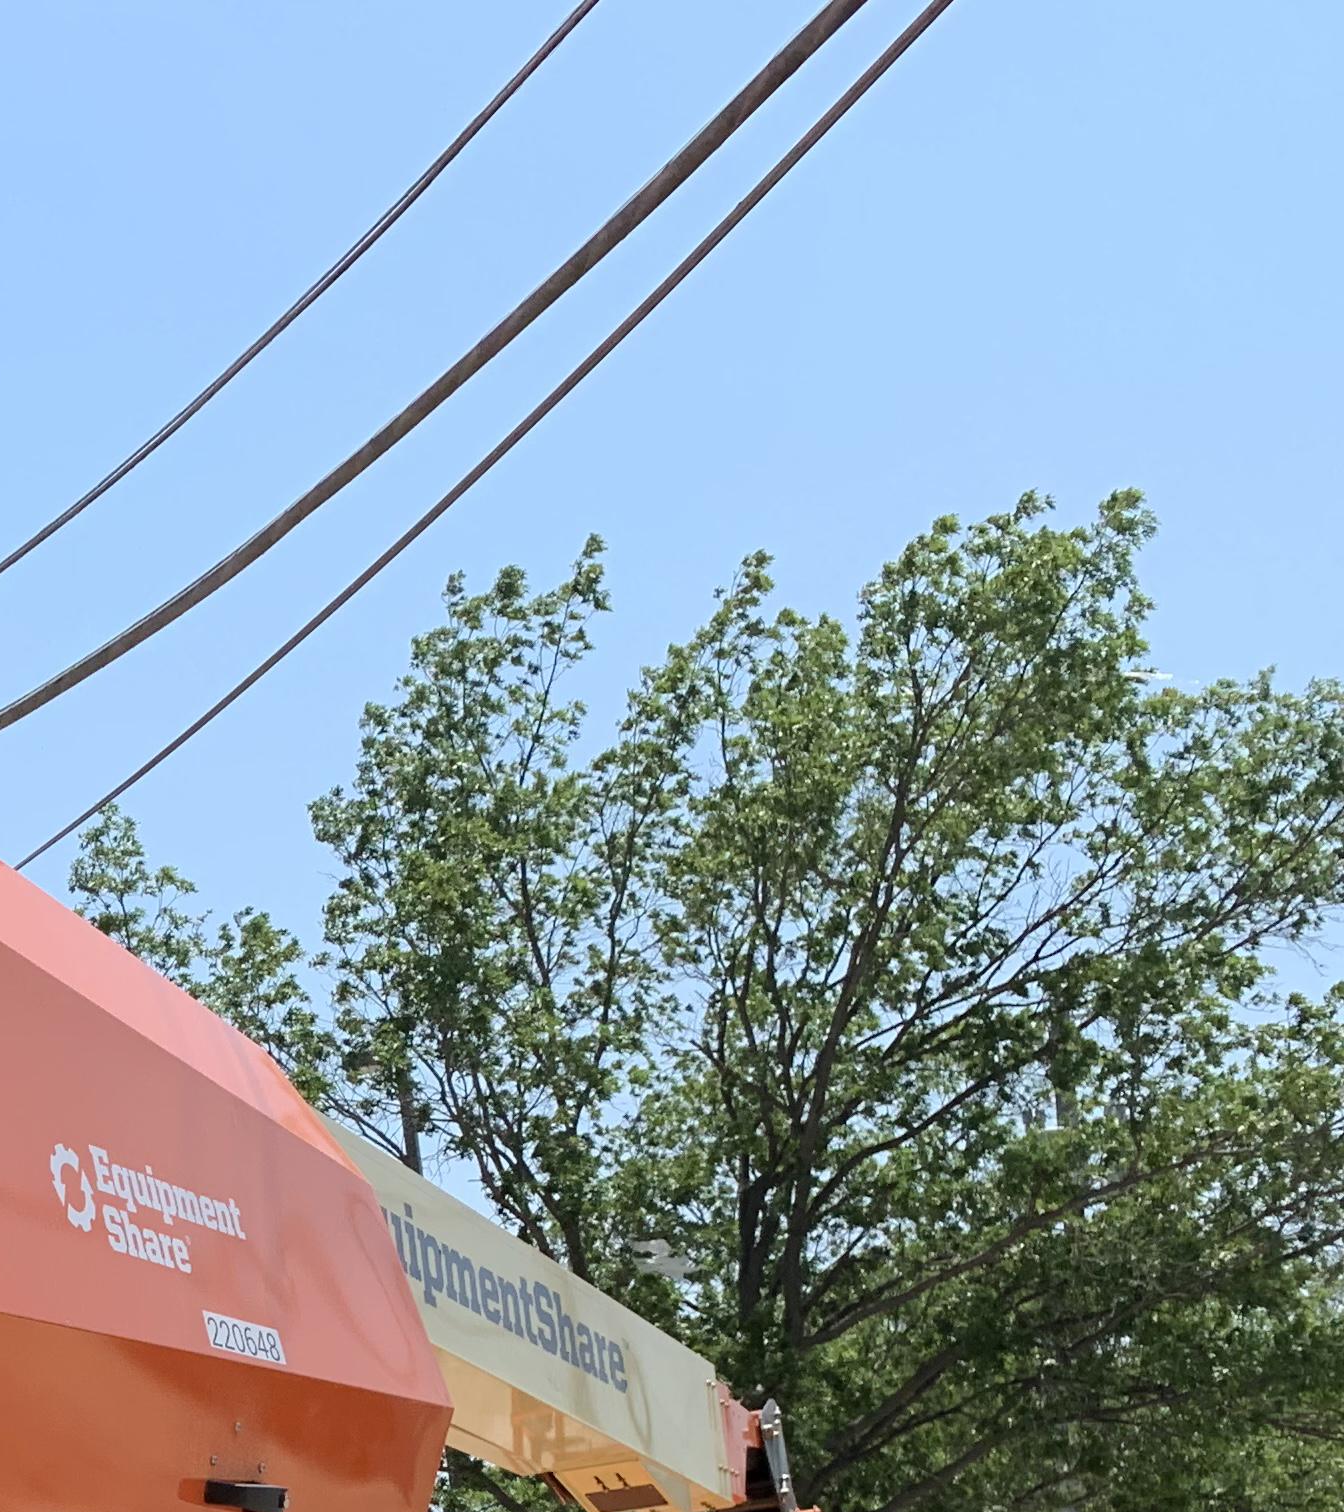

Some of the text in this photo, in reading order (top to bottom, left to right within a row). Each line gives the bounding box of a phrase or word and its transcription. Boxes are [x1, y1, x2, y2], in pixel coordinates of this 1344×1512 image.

[88, 1144, 247, 1241] Equipment
[102, 1204, 192, 1274] Share
[207, 1316, 281, 1362] 220648
